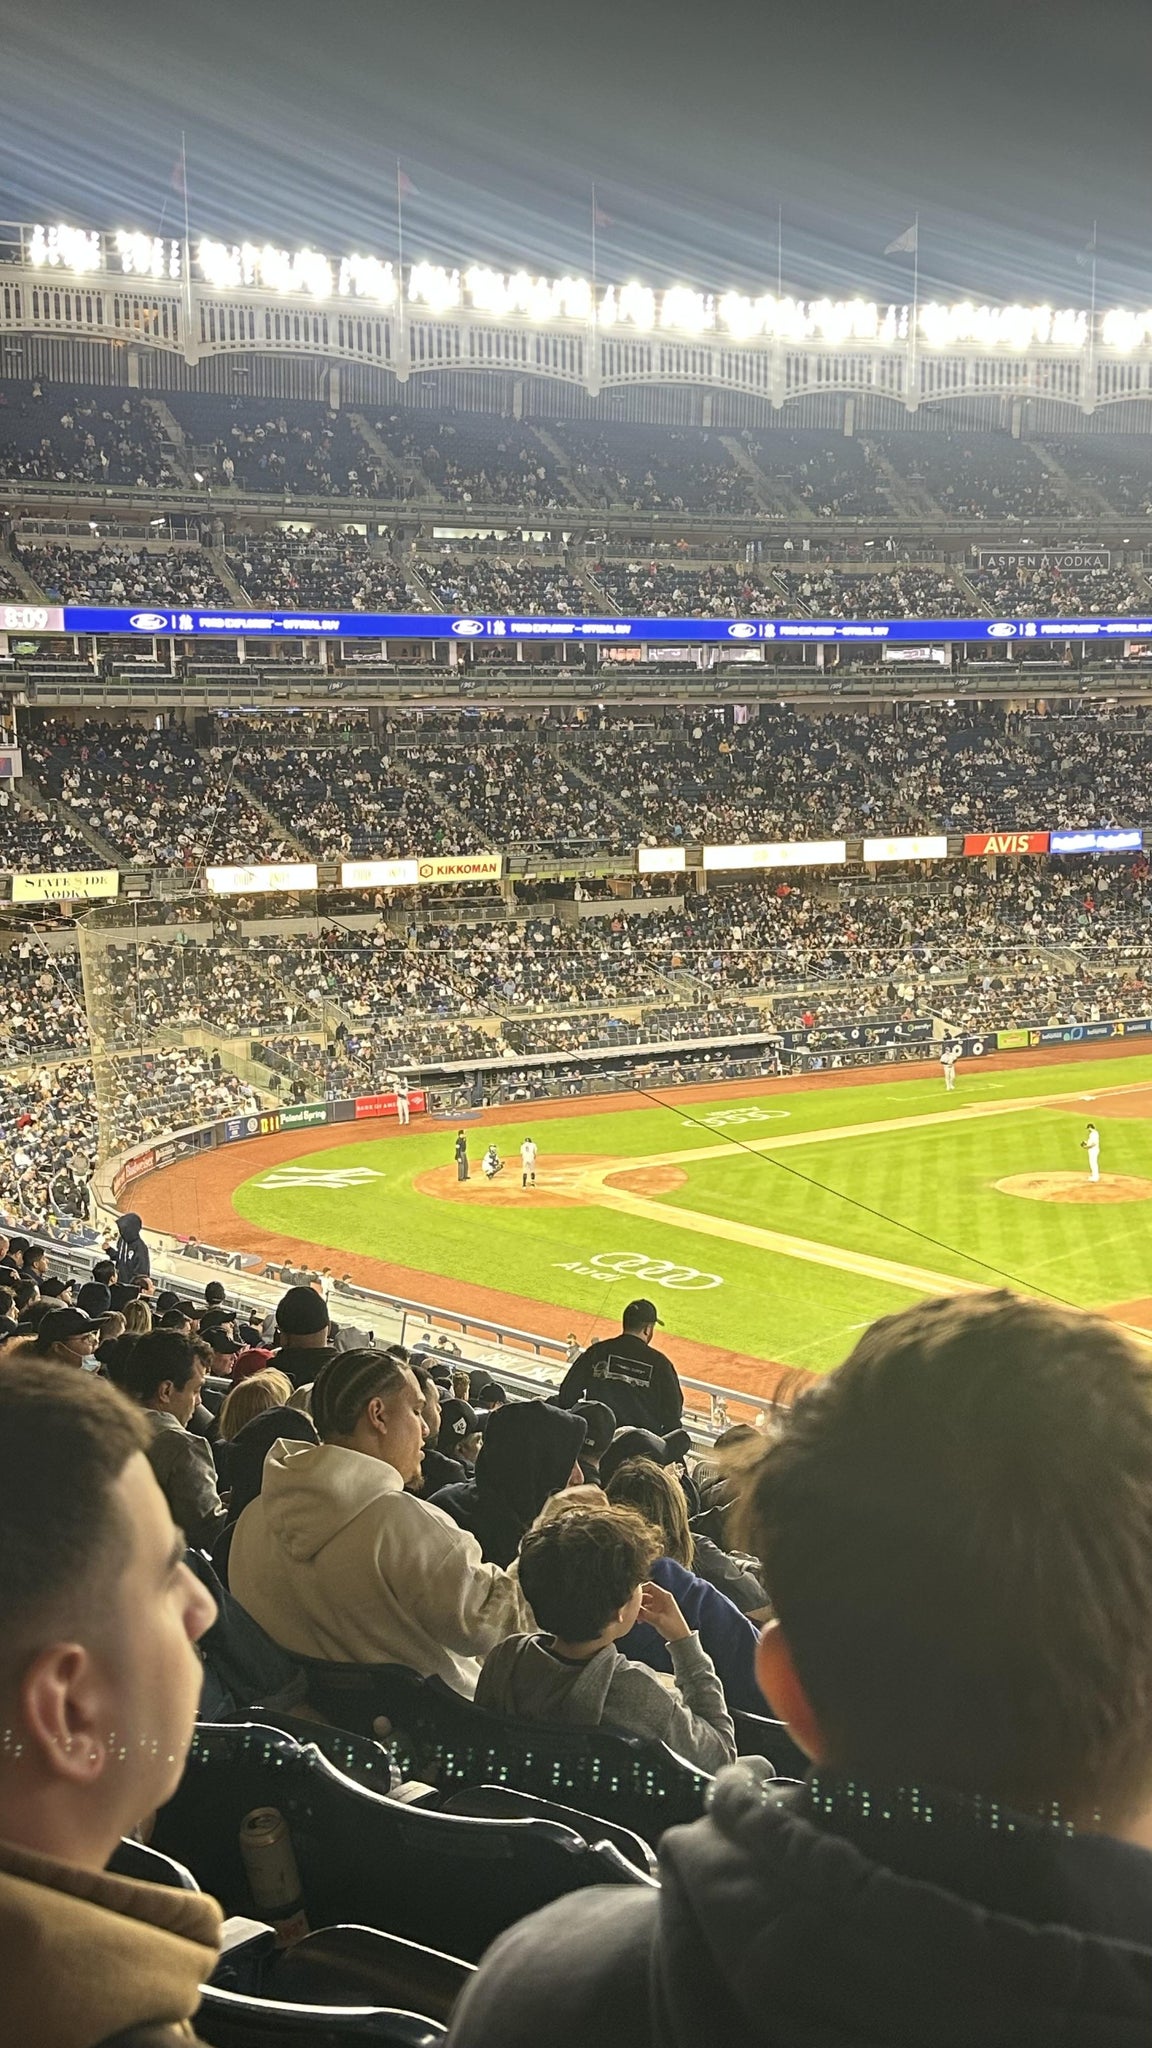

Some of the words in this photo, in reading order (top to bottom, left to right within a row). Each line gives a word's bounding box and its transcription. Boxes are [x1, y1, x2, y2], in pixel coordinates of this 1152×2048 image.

[987, 556, 1036, 567] ASPEN
[1055, 556, 1102, 567] VODKA
[4, 607, 48, 630] 8:09
[983, 835, 1029, 854] AVIS
[437, 863, 497, 875] KIKKOMAN
[280, 1112, 303, 1125] Poland
[303, 1110, 327, 1121] Spring
[551, 1261, 627, 1283] Audi
